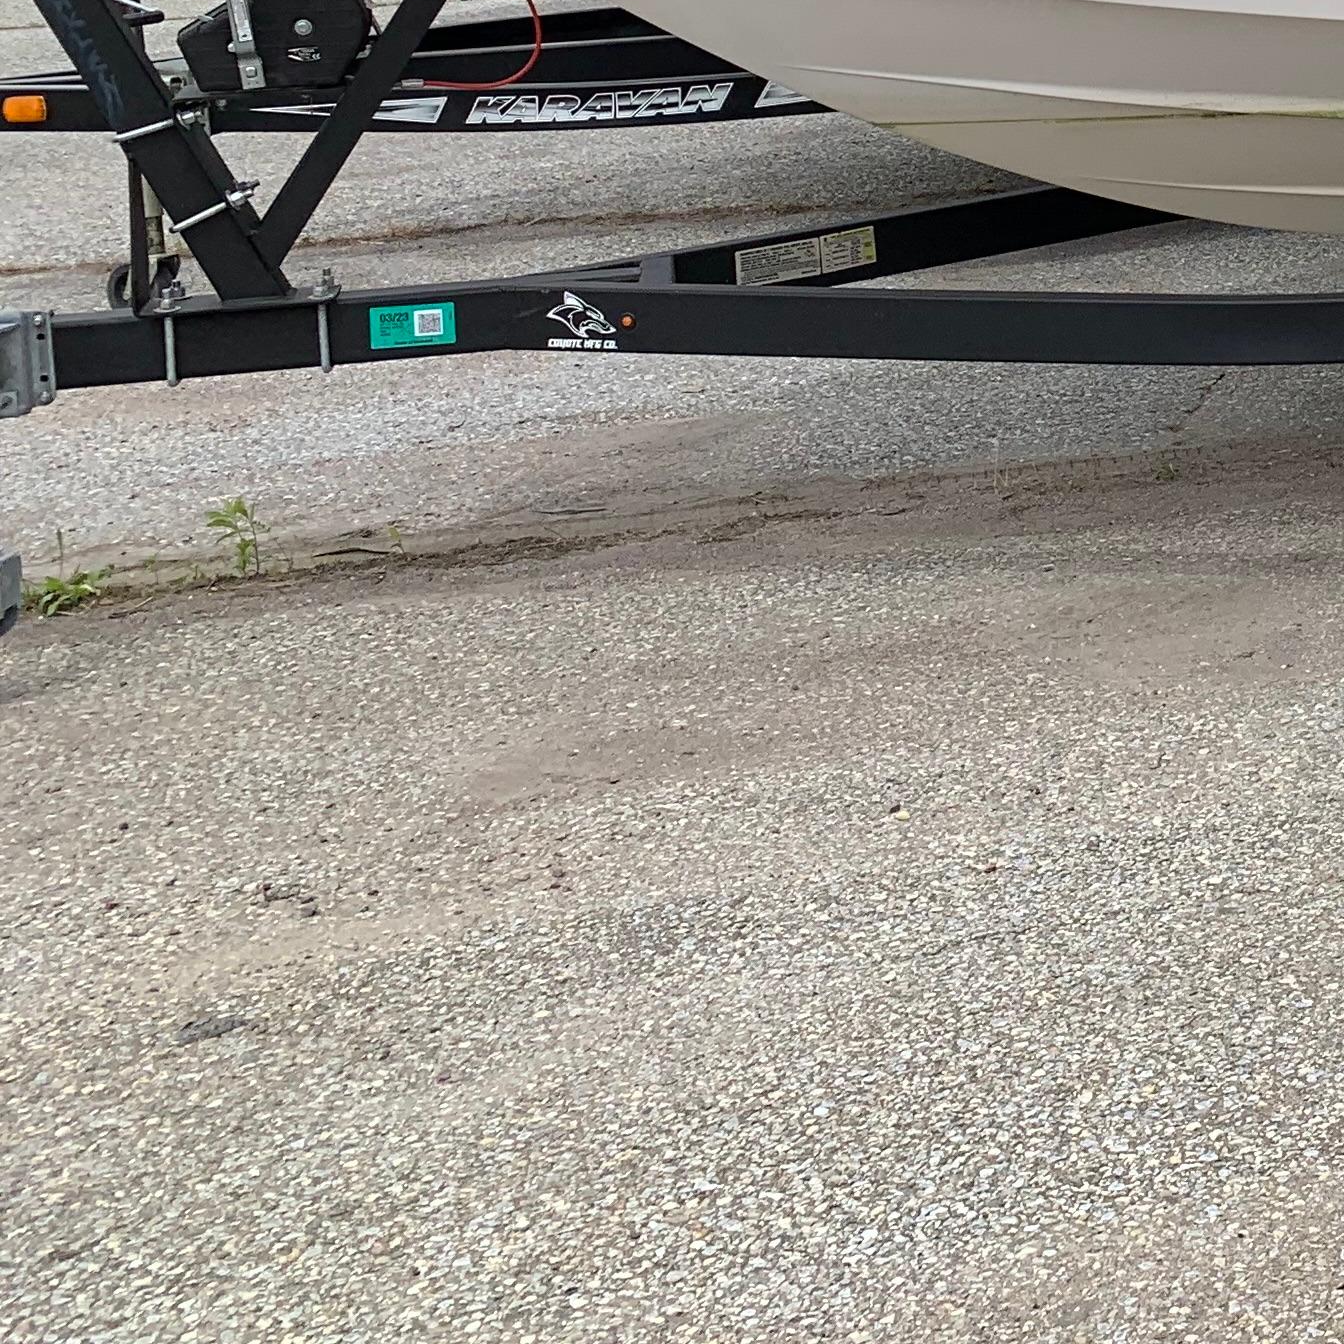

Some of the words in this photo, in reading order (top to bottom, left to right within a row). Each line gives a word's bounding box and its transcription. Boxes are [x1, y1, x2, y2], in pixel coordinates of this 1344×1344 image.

[465, 83, 733, 124] KARAVAN
[379, 312, 409, 323] 03/23
[548, 338, 583, 349] COYOTE
